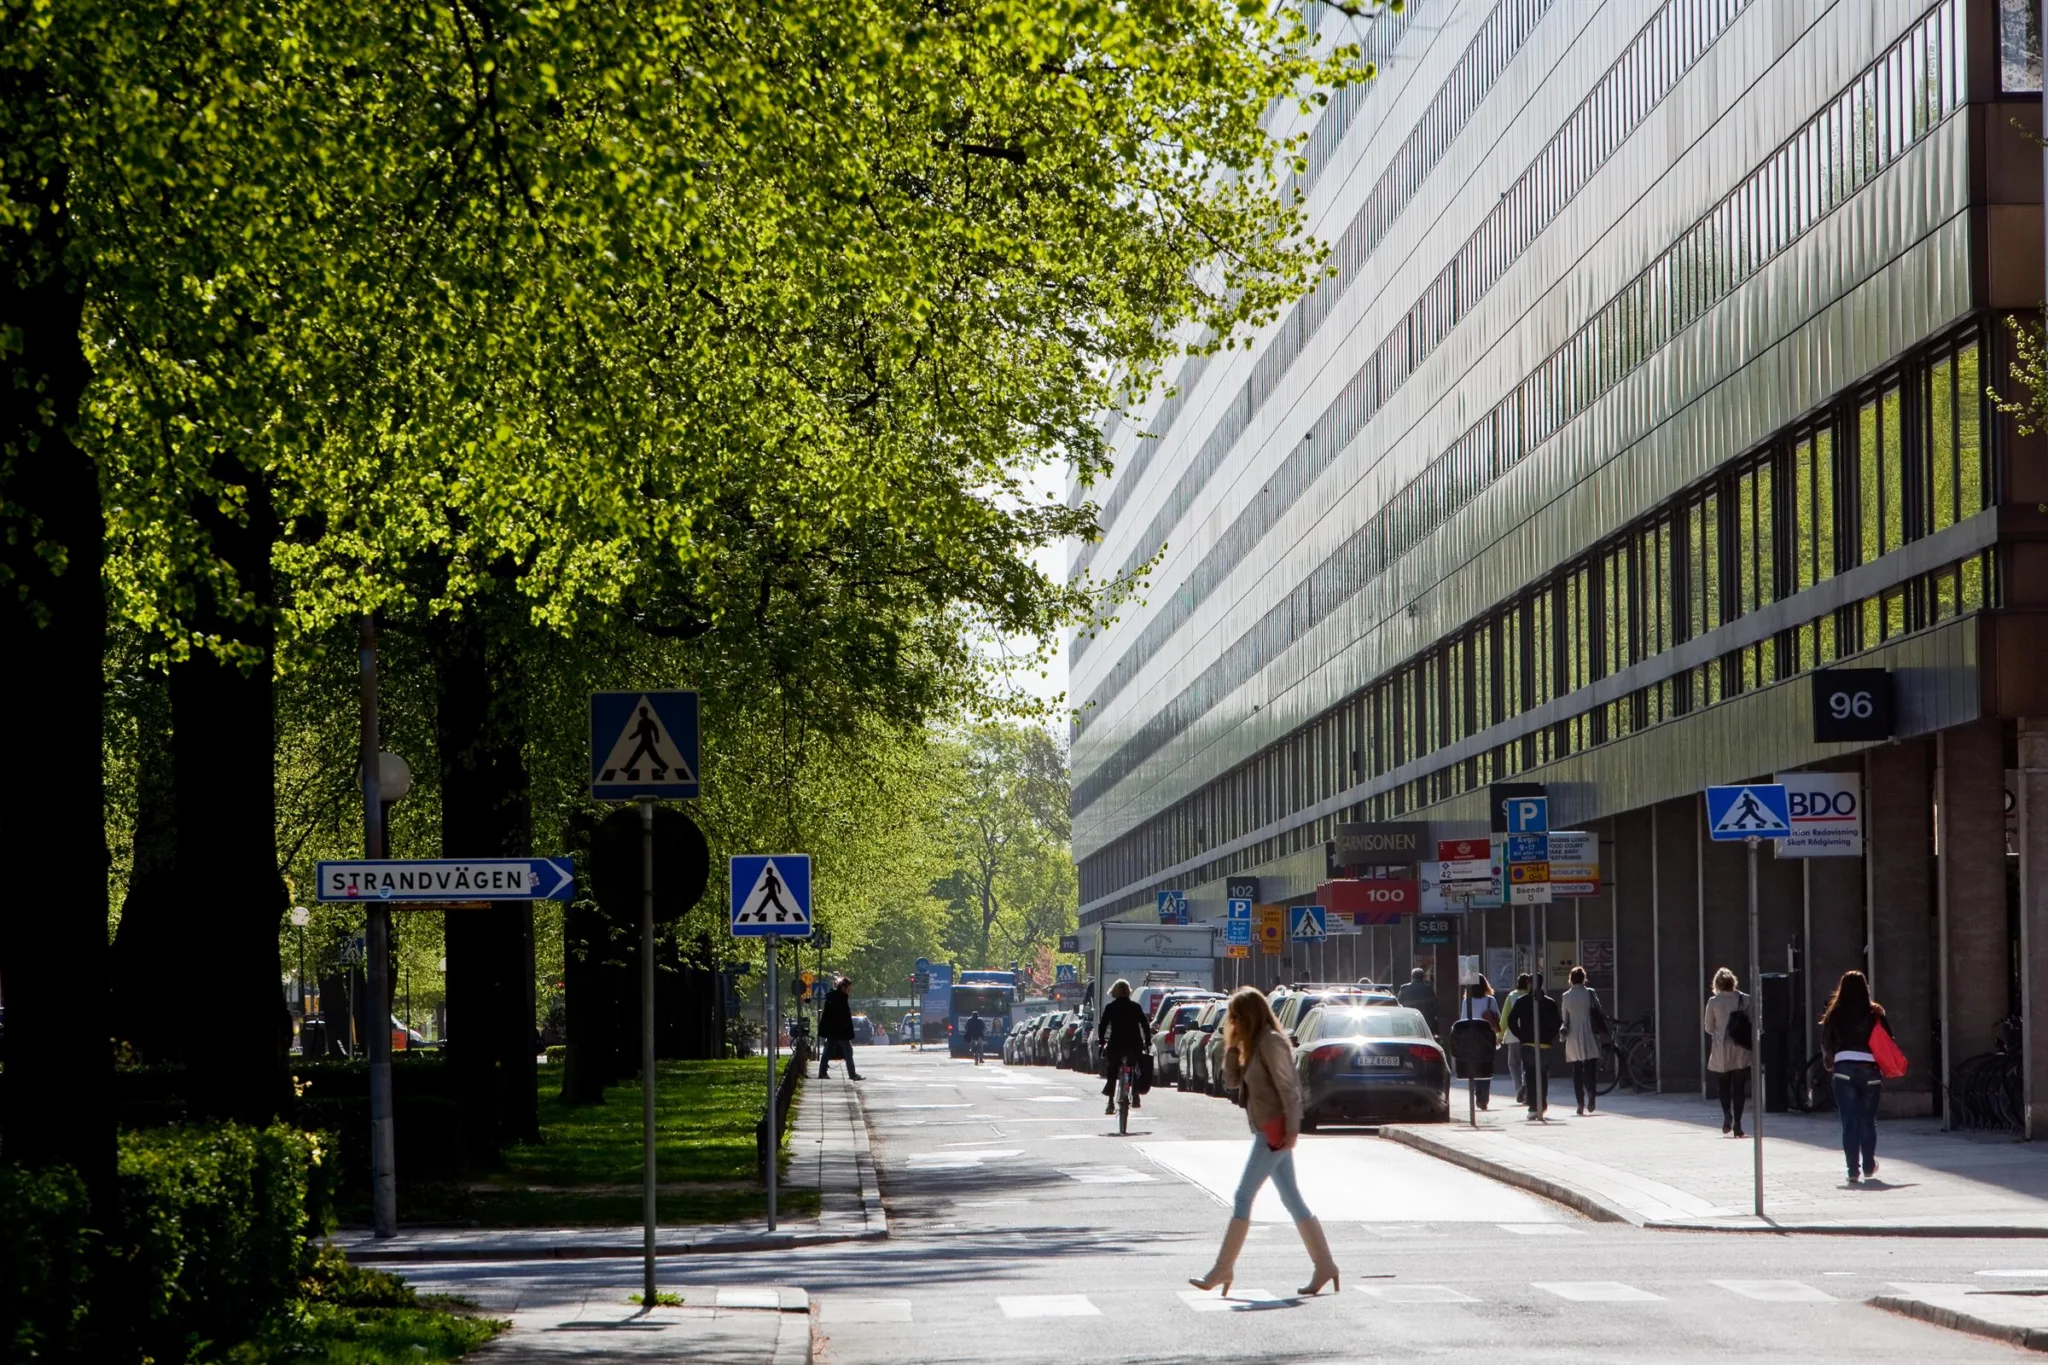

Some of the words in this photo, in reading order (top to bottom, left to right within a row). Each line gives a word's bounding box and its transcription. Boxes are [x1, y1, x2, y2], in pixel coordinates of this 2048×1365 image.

[1829, 691, 1873, 719] 96
[1789, 791, 1857, 816] BDO
[1519, 802, 1538, 831] P
[1812, 827, 1859, 838] Redovisning
[1808, 836, 1851, 847] Rådgivning
[332, 867, 522, 890] STRANDVÄGEN
[1231, 886, 1254, 897] 102
[1367, 889, 1405, 902] 100
[1179, 902, 1186, 915] P
[1234, 901, 1247, 918] P
[1419, 921, 1449, 933] SEB
[1062, 941, 1074, 949] 112
